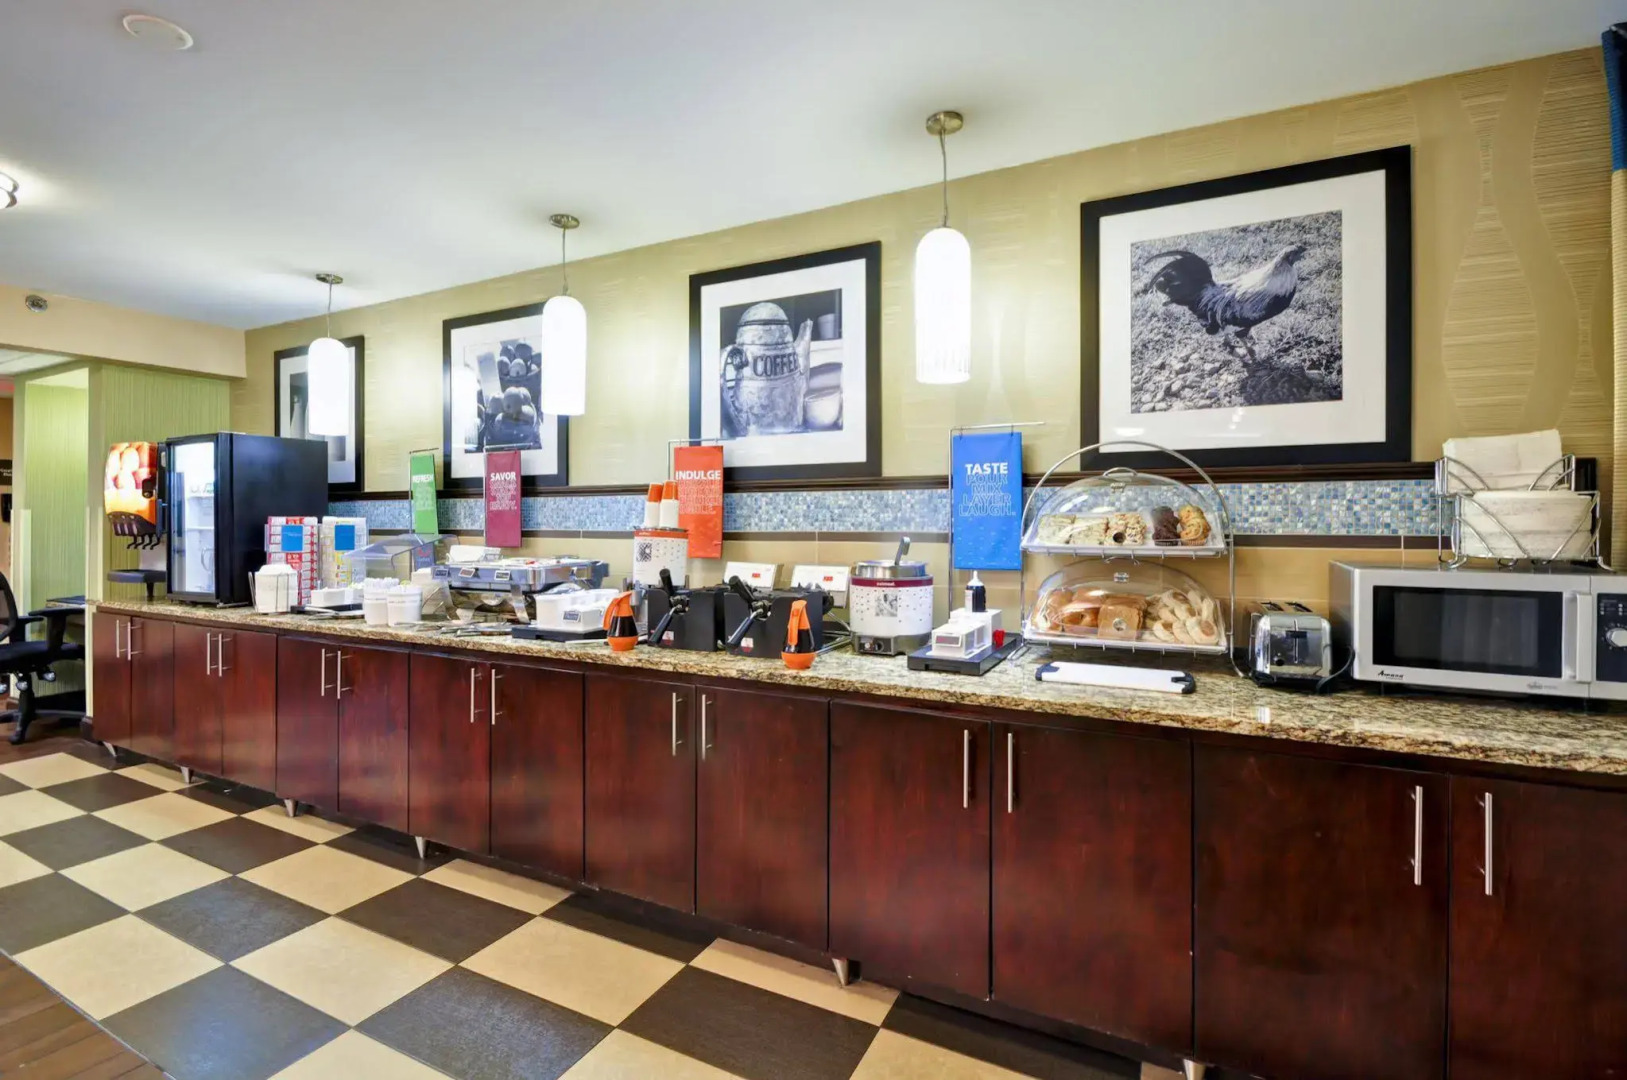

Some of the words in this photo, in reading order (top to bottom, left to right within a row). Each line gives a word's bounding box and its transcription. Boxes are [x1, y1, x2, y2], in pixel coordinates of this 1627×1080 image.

[753, 352, 799, 377] COFFEE
[965, 462, 1009, 475] TASTE
[490, 471, 517, 481] SAVOR
[675, 470, 721, 480] INDULGE
[966, 474, 1008, 485] POUR
[972, 483, 1003, 495] MIX
[963, 494, 1012, 506] LAYER
